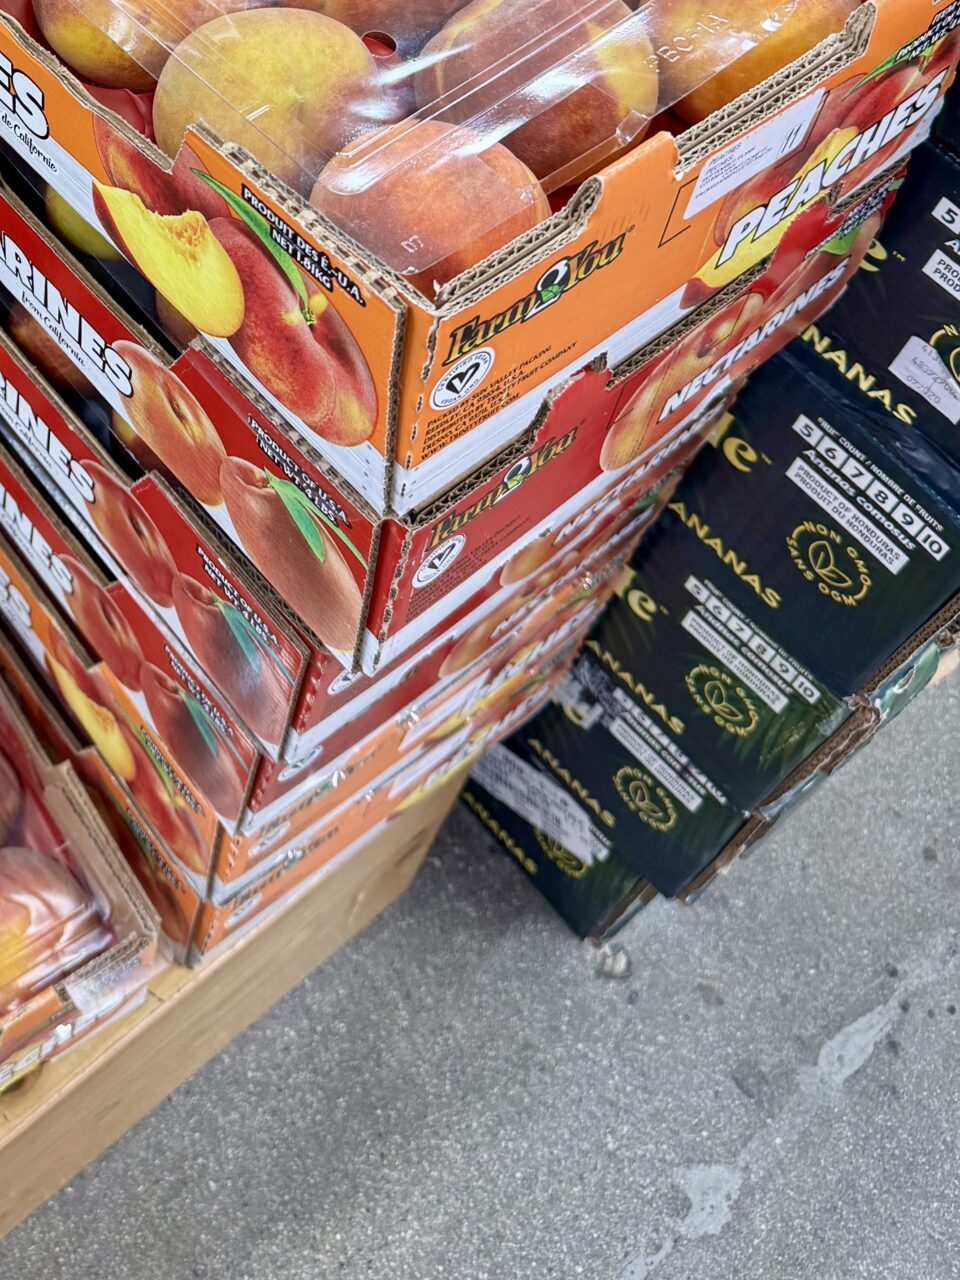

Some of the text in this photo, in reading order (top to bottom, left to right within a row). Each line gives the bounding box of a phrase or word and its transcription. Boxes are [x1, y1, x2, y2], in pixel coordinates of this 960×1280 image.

[1, 111, 57, 174] de Californie
[717, 66, 950, 267] PEACHES
[243, 187, 295, 240] PRODUIT
[296, 236, 320, 262] DES
[272, 229, 294, 255] NET
[941, 207, 959, 224] 5
[20, 289, 87, 368] from California
[800, 324, 918, 425] NANAS
[251, 421, 300, 472] PRODUCT
[301, 473, 317, 489] OF
[260, 441, 280, 463] NET
[800, 423, 943, 555] 5 6 7 8 9 10
[839, 437, 867, 463] COUNT
[870, 463, 903, 494] NOMBRE
[903, 493, 916, 506] DE
[915, 503, 944, 532] FRUITS
[794, 471, 895, 565] PRODUIT DU HONDURAS
[797, 464, 901, 561] PRODUCT OF HONDURAS
[802, 448, 917, 552] Ananas comosus
[197, 545, 242, 599] PRODUCT
[240, 592, 254, 613] OF
[204, 564, 224, 588] NET
[669, 501, 782, 609] ANANAS
[786, 535, 858, 607] SANS OGM
[803, 520, 872, 586] NON GMO
[585, 640, 686, 736] ANANAS
[795, 679, 816, 700] 10
